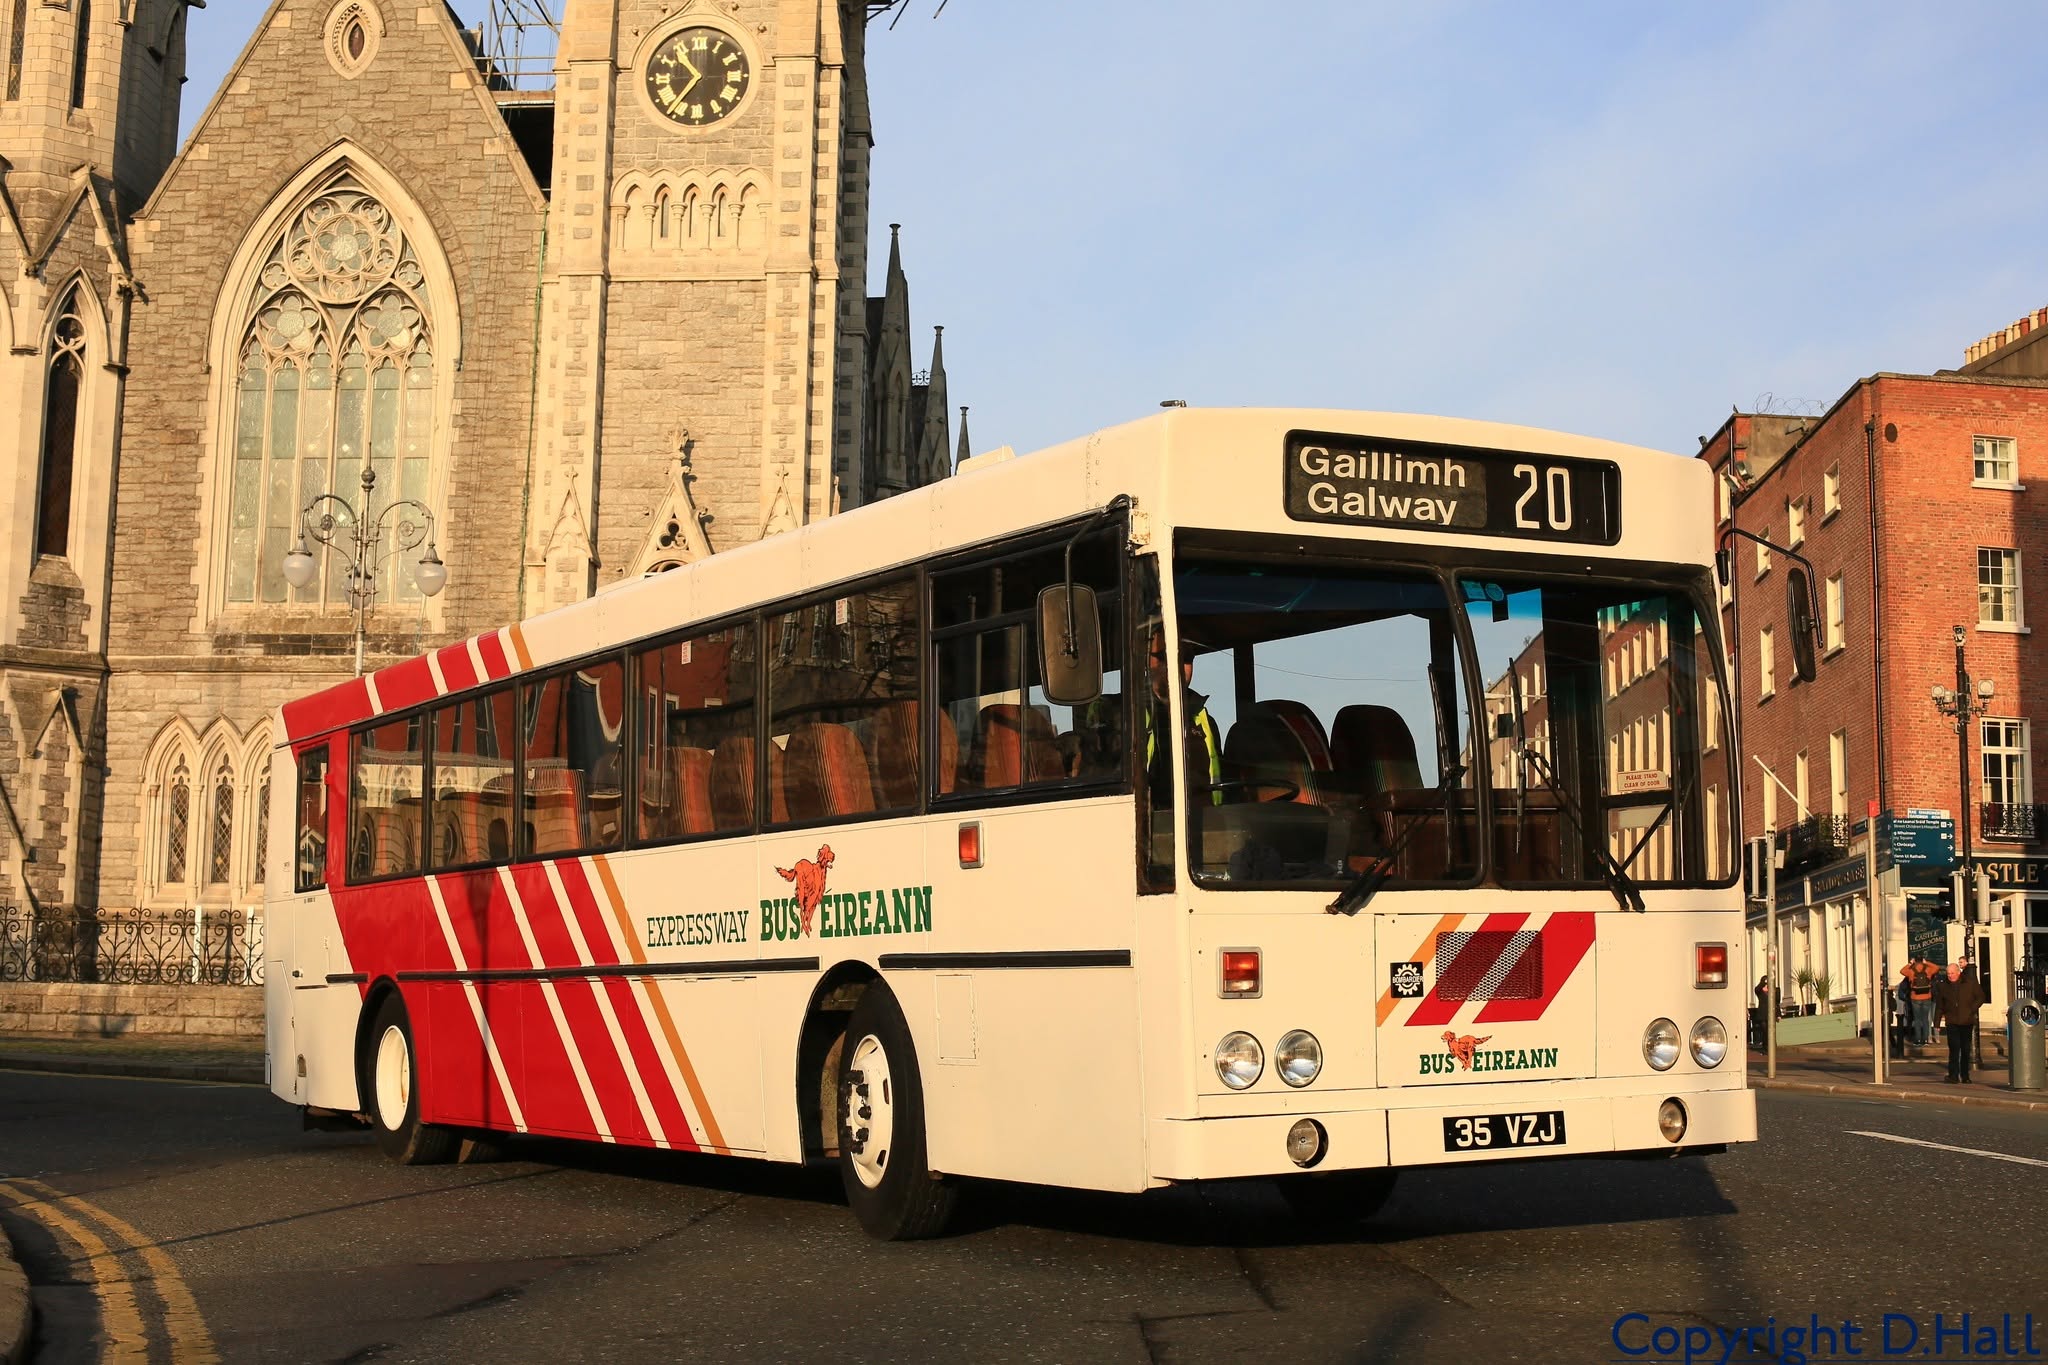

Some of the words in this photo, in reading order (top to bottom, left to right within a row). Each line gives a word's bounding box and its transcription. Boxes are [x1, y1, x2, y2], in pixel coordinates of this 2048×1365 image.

[1299, 446, 1466, 487] Gaillimh
[1307, 482, 1458, 526] Galway
[1513, 463, 1572, 531] 20
[1960, 863, 2039, 883] ASTLE
[646, 910, 749, 947] EXPRESSWAY
[760, 898, 801, 941] BUS
[1914, 930, 1939, 942] CASTLE
[1922, 936, 1945, 948] ROOMS
[1392, 975, 1424, 984] BOMBARDIER
[1419, 1053, 1455, 1075] BUS
[1455, 1117, 1492, 1148] 35
[1504, 1114, 1556, 1144] VZJ
